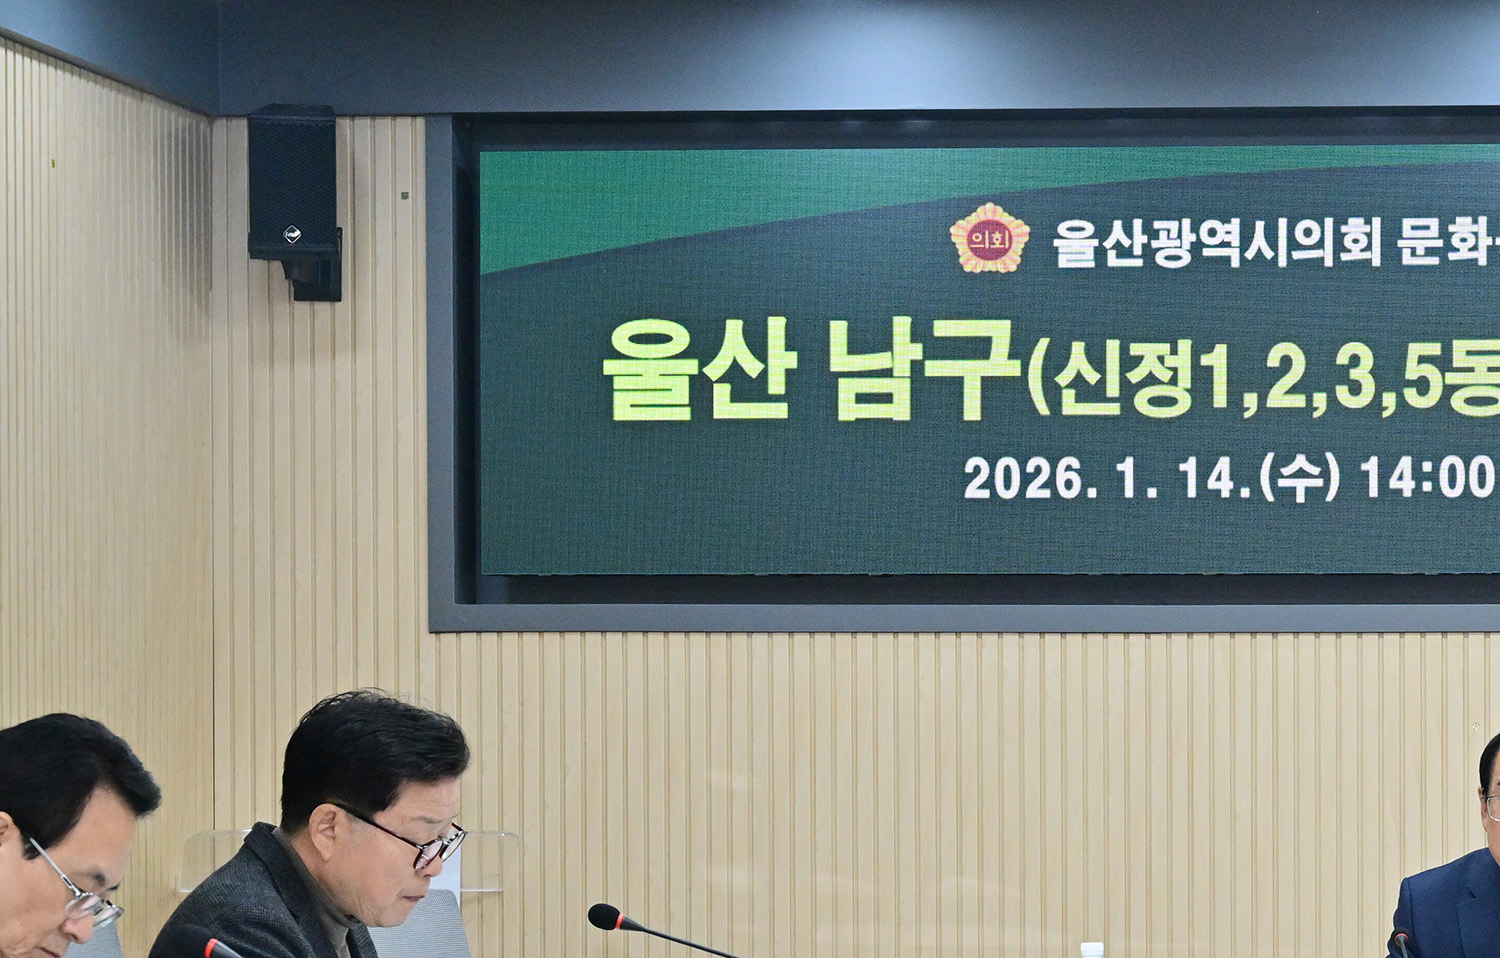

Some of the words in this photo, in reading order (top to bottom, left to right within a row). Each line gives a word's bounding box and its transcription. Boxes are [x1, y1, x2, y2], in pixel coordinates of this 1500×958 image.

[970, 230, 1009, 249] 의회
[1053, 217, 1383, 269] 울산광역시의회
[602, 317, 799, 422] 울산
[965, 457, 1098, 501] 2026.
[1117, 457, 1159, 500] 1.
[1179, 452, 1341, 505] 14.(수)
[1361, 455, 1497, 499] 14:00
